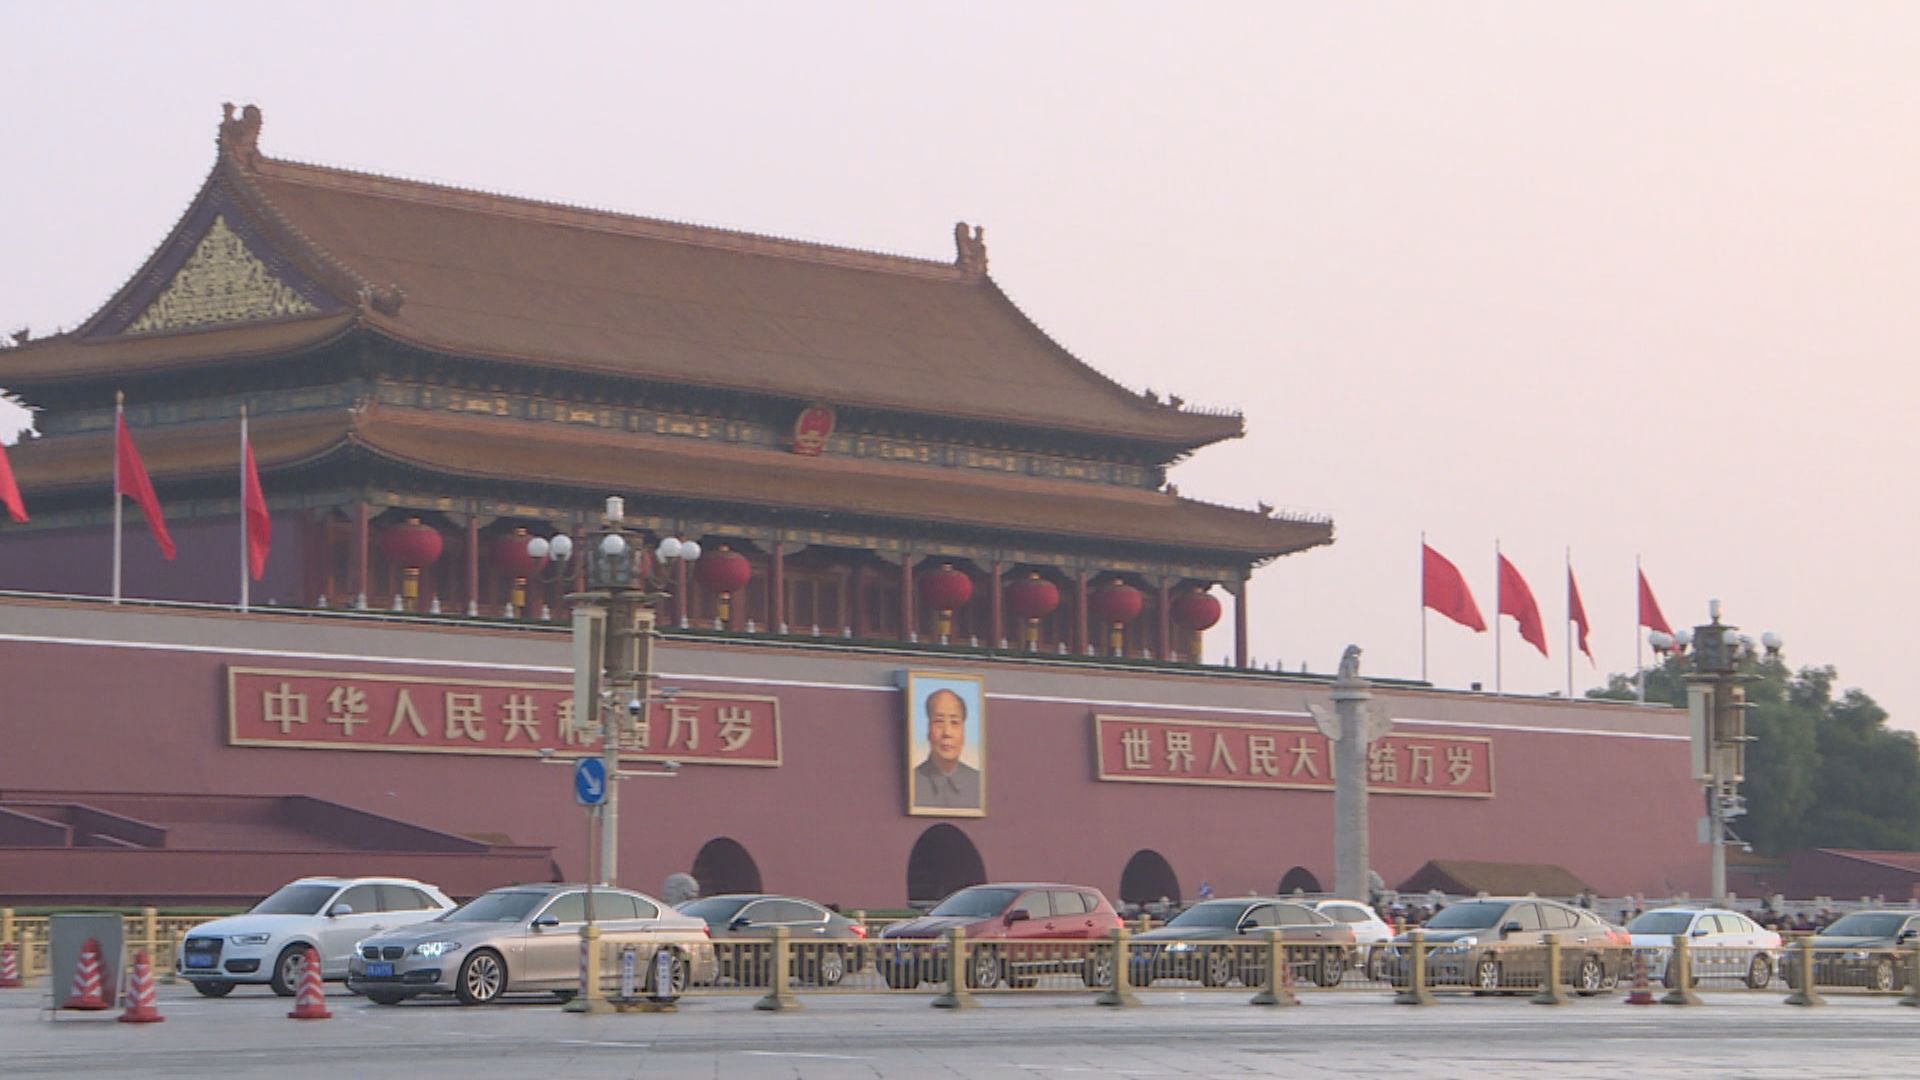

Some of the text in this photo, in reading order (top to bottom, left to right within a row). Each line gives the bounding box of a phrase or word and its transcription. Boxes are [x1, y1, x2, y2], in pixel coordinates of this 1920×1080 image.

[1121, 728, 1474, 786] 世界人民大结万岁
